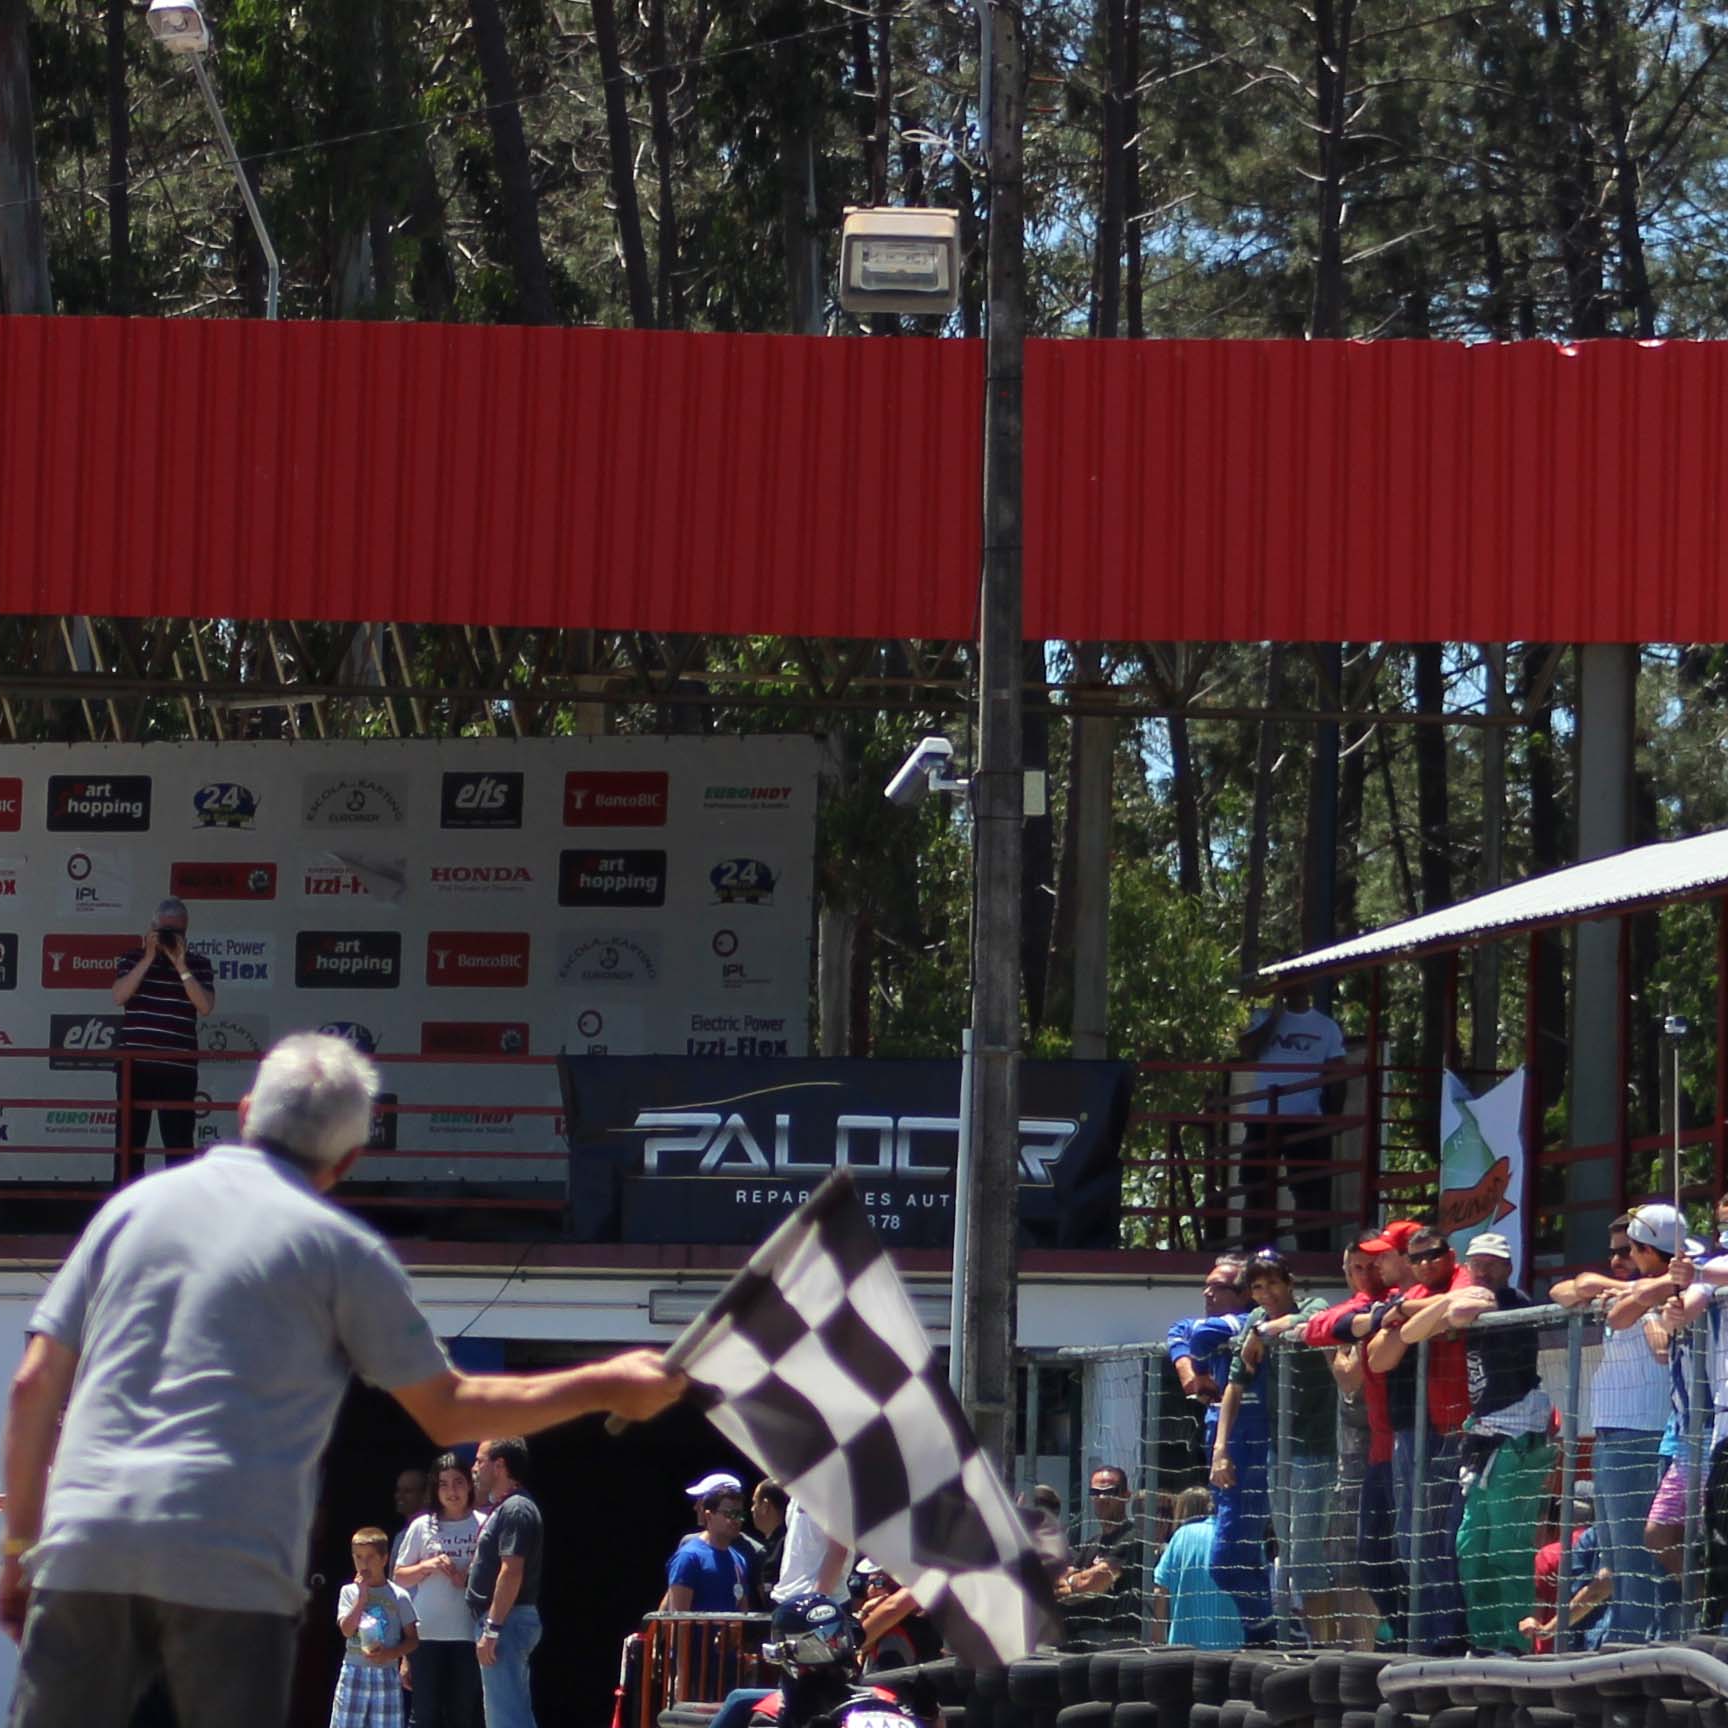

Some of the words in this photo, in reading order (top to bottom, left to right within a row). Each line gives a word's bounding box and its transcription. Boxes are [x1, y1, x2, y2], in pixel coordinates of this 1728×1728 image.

[594, 793, 660, 807] BancoBIC
[703, 787, 793, 799] EUROINDY
[431, 867, 534, 881] HONDA
[75, 888, 99, 900] IPL
[226, 939, 266, 955] Power
[458, 953, 522, 968] BancoBIC
[691, 1015, 740, 1031] Electric
[744, 1016, 787, 1032] Power
[46, 1111, 116, 1124] EUROIND
